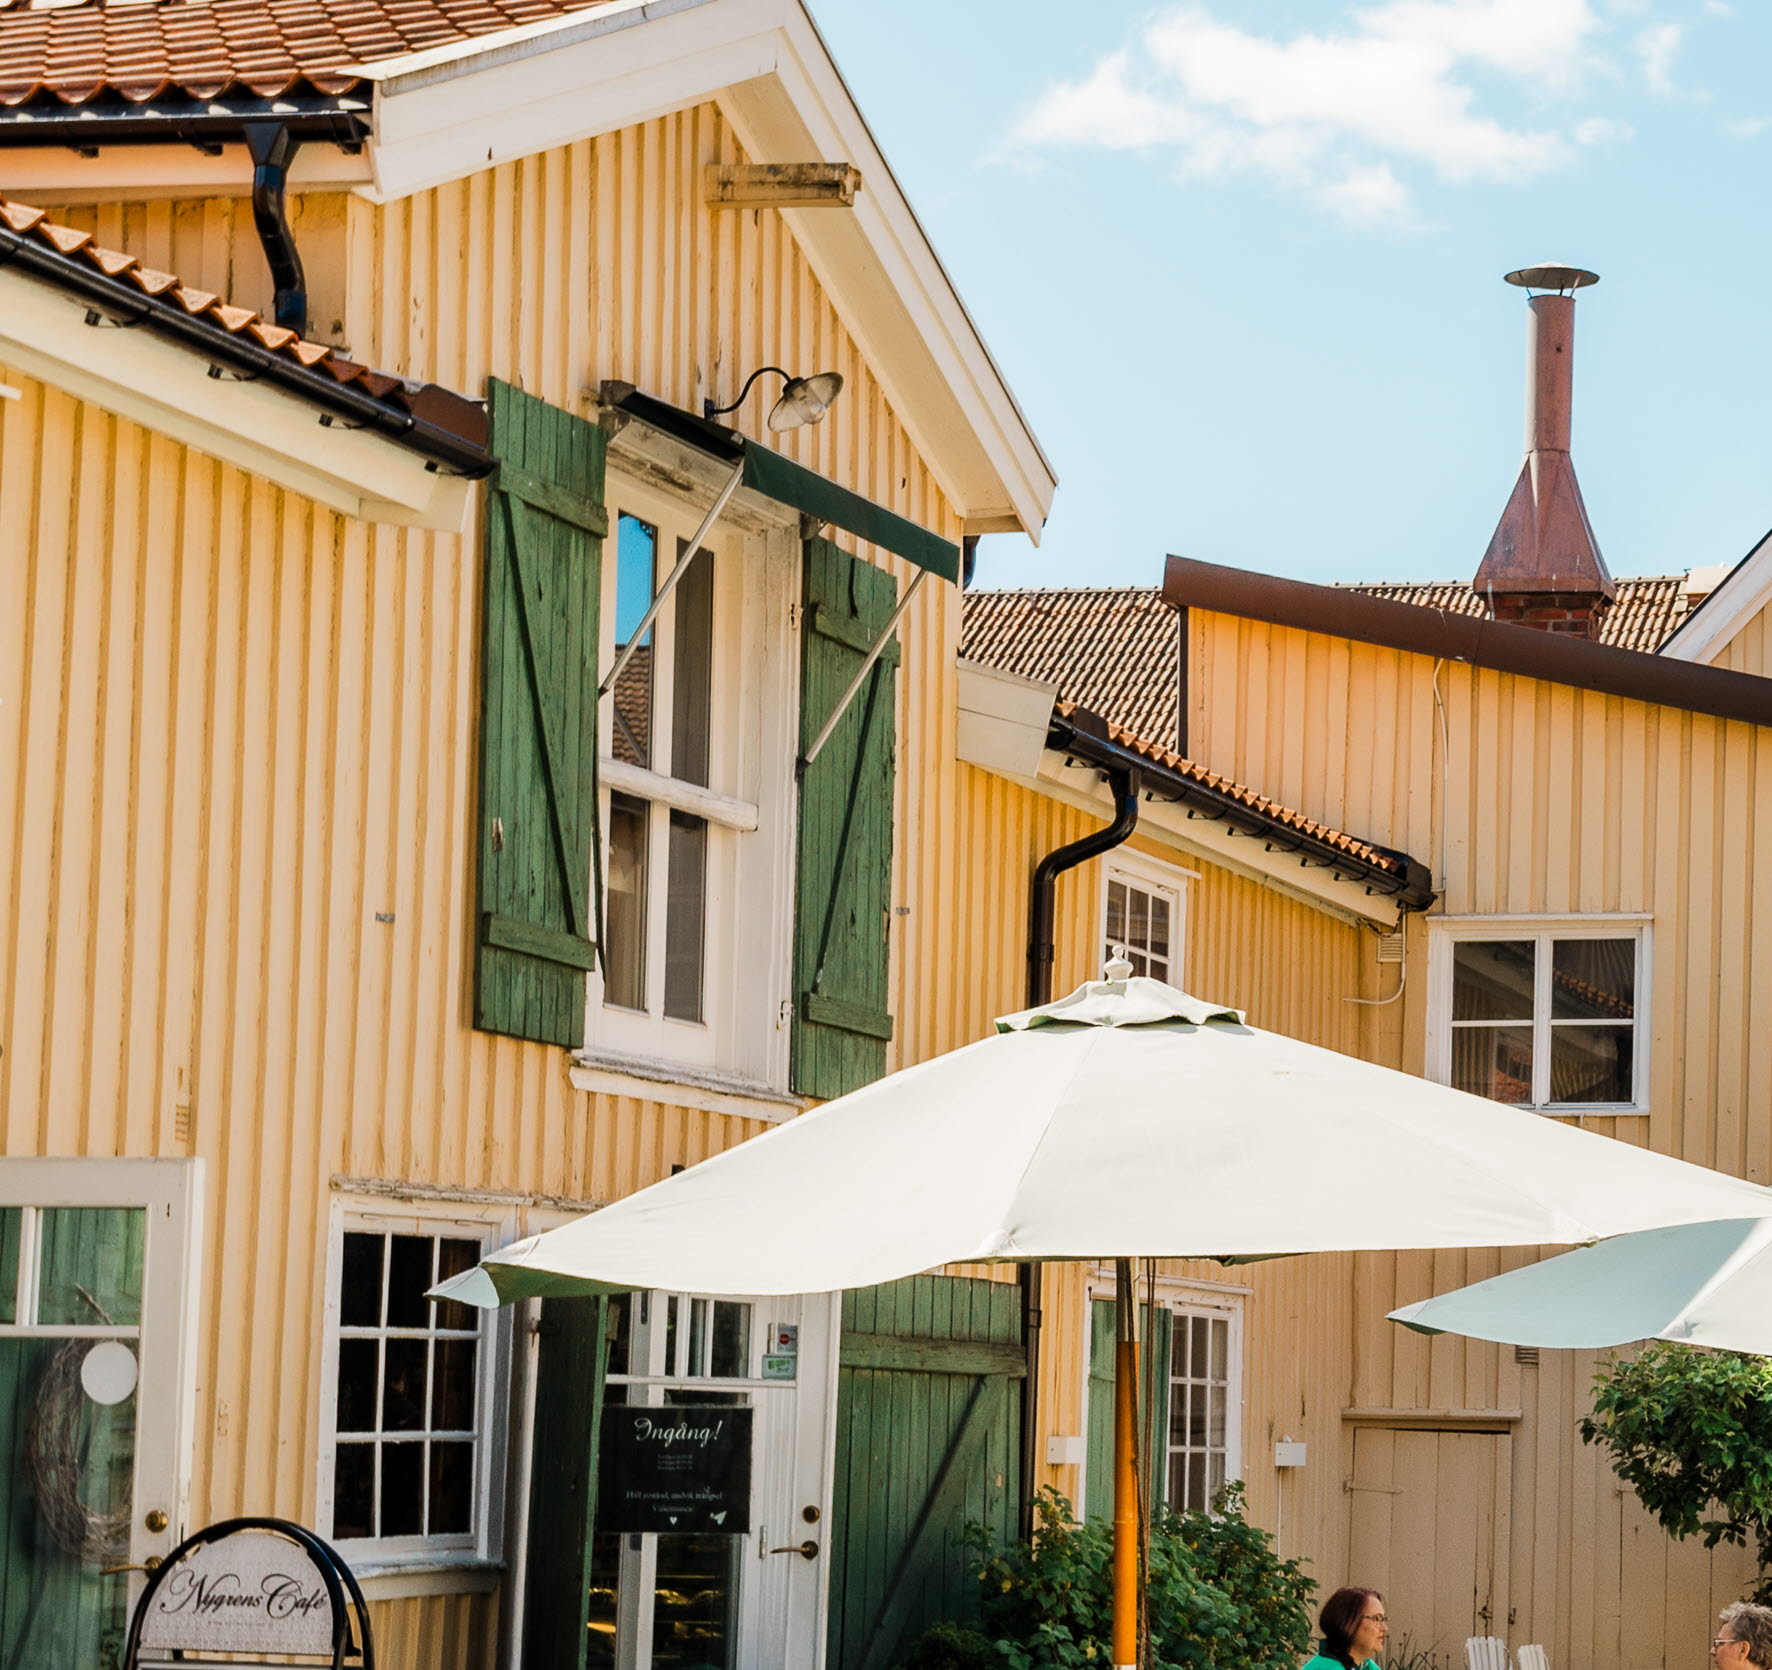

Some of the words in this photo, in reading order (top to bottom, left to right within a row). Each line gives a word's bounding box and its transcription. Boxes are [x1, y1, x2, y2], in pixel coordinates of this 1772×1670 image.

[634, 1417, 723, 1448] Ingång!
[160, 1569, 264, 1614] Nygrens
[261, 1573, 328, 1619] Café
